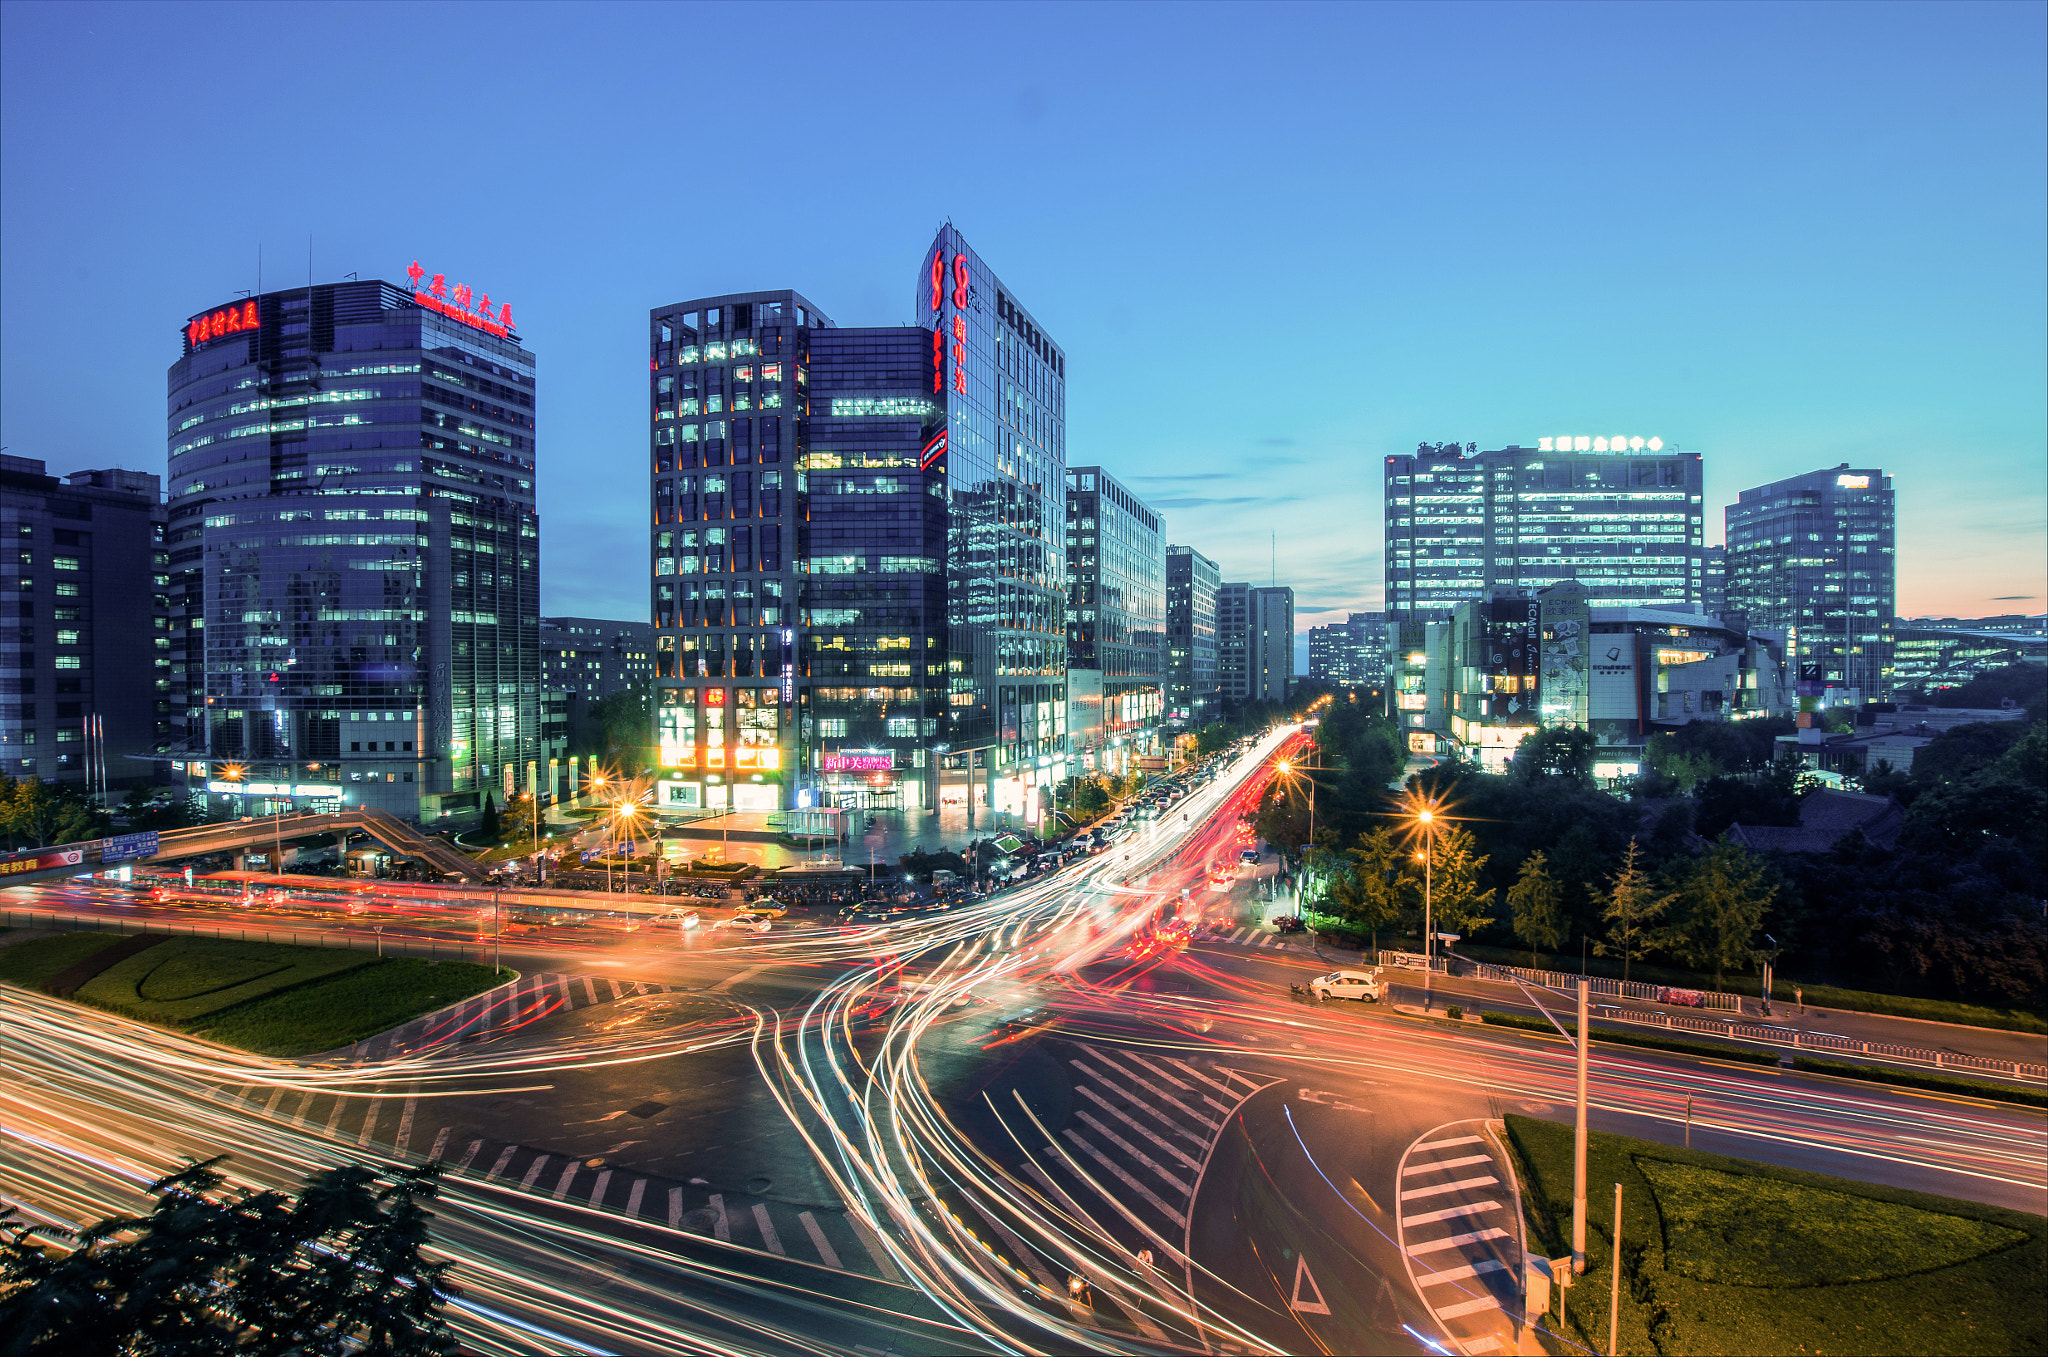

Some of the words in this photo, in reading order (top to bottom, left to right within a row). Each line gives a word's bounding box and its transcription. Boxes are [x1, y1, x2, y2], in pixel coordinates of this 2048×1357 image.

[407, 260, 516, 329] 中关村大厦
[1528, 603, 1537, 639] ECMall
[825, 756, 862, 770] 新中关
